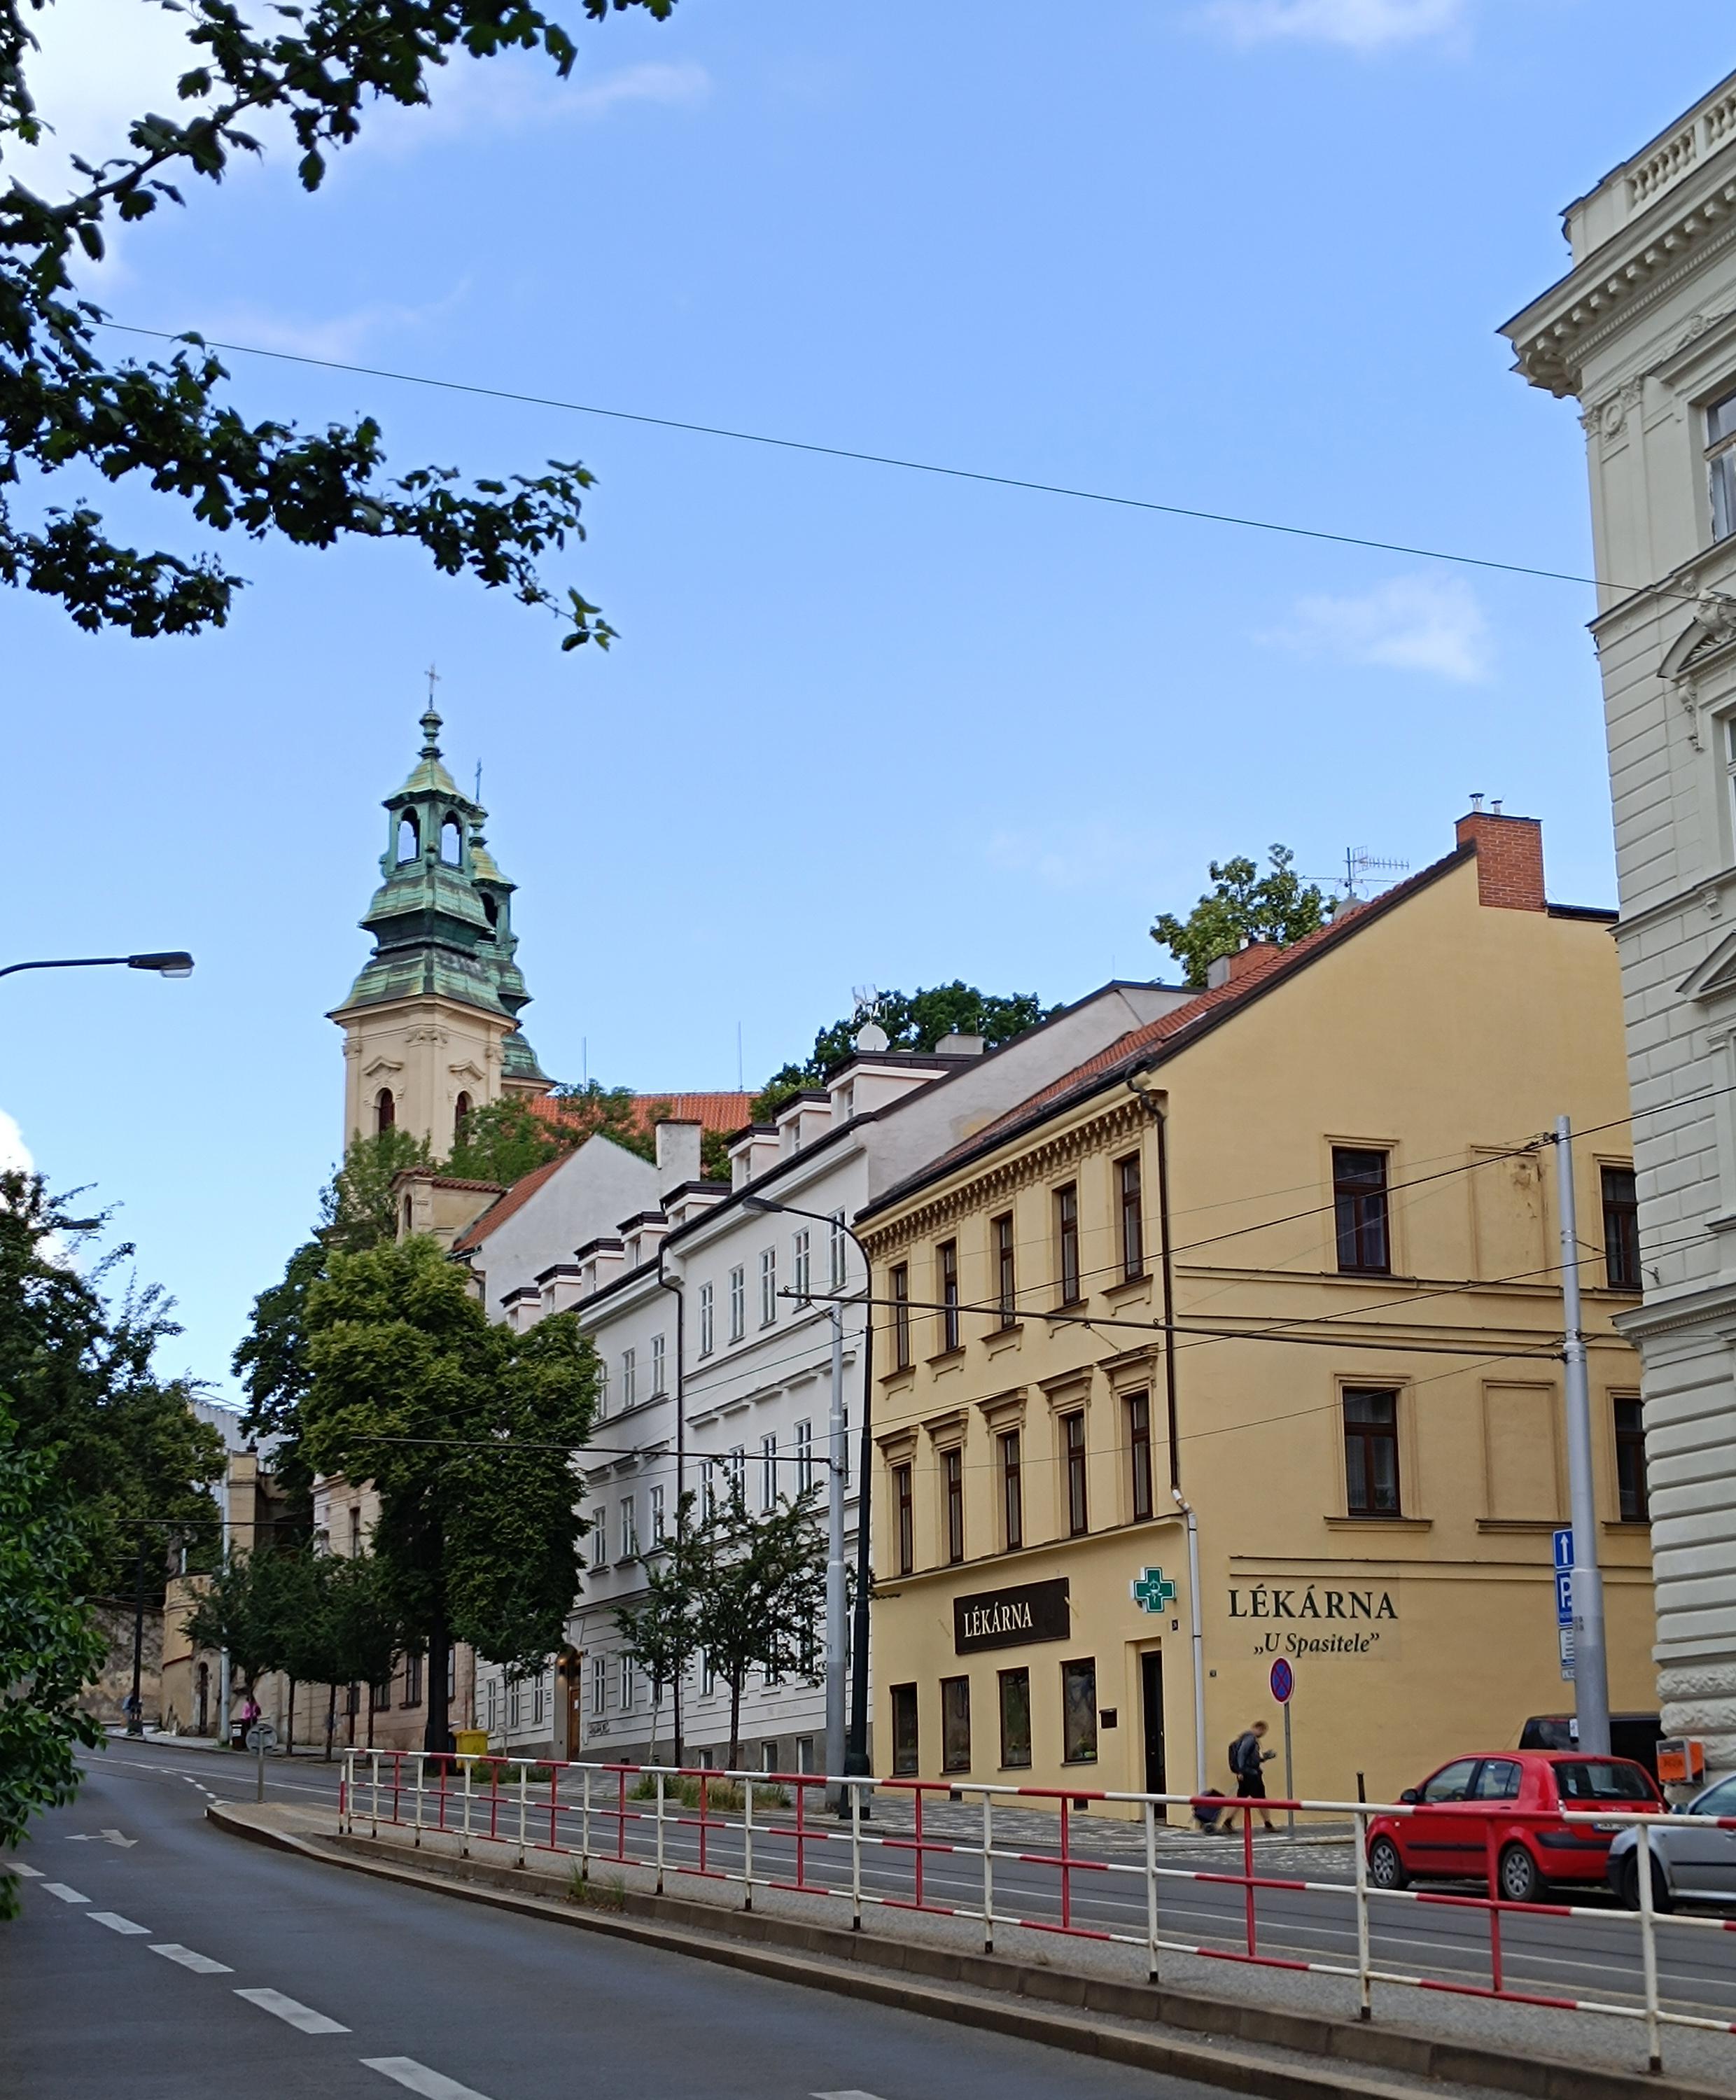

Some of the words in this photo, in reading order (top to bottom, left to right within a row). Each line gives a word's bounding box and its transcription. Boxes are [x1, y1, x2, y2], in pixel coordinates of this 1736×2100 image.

[1228, 1583, 1399, 1619] LÉKÁRNA
[964, 1602, 1034, 1638] LÉKÁRNA
[1285, 1632, 1380, 1658] Spasitele”
